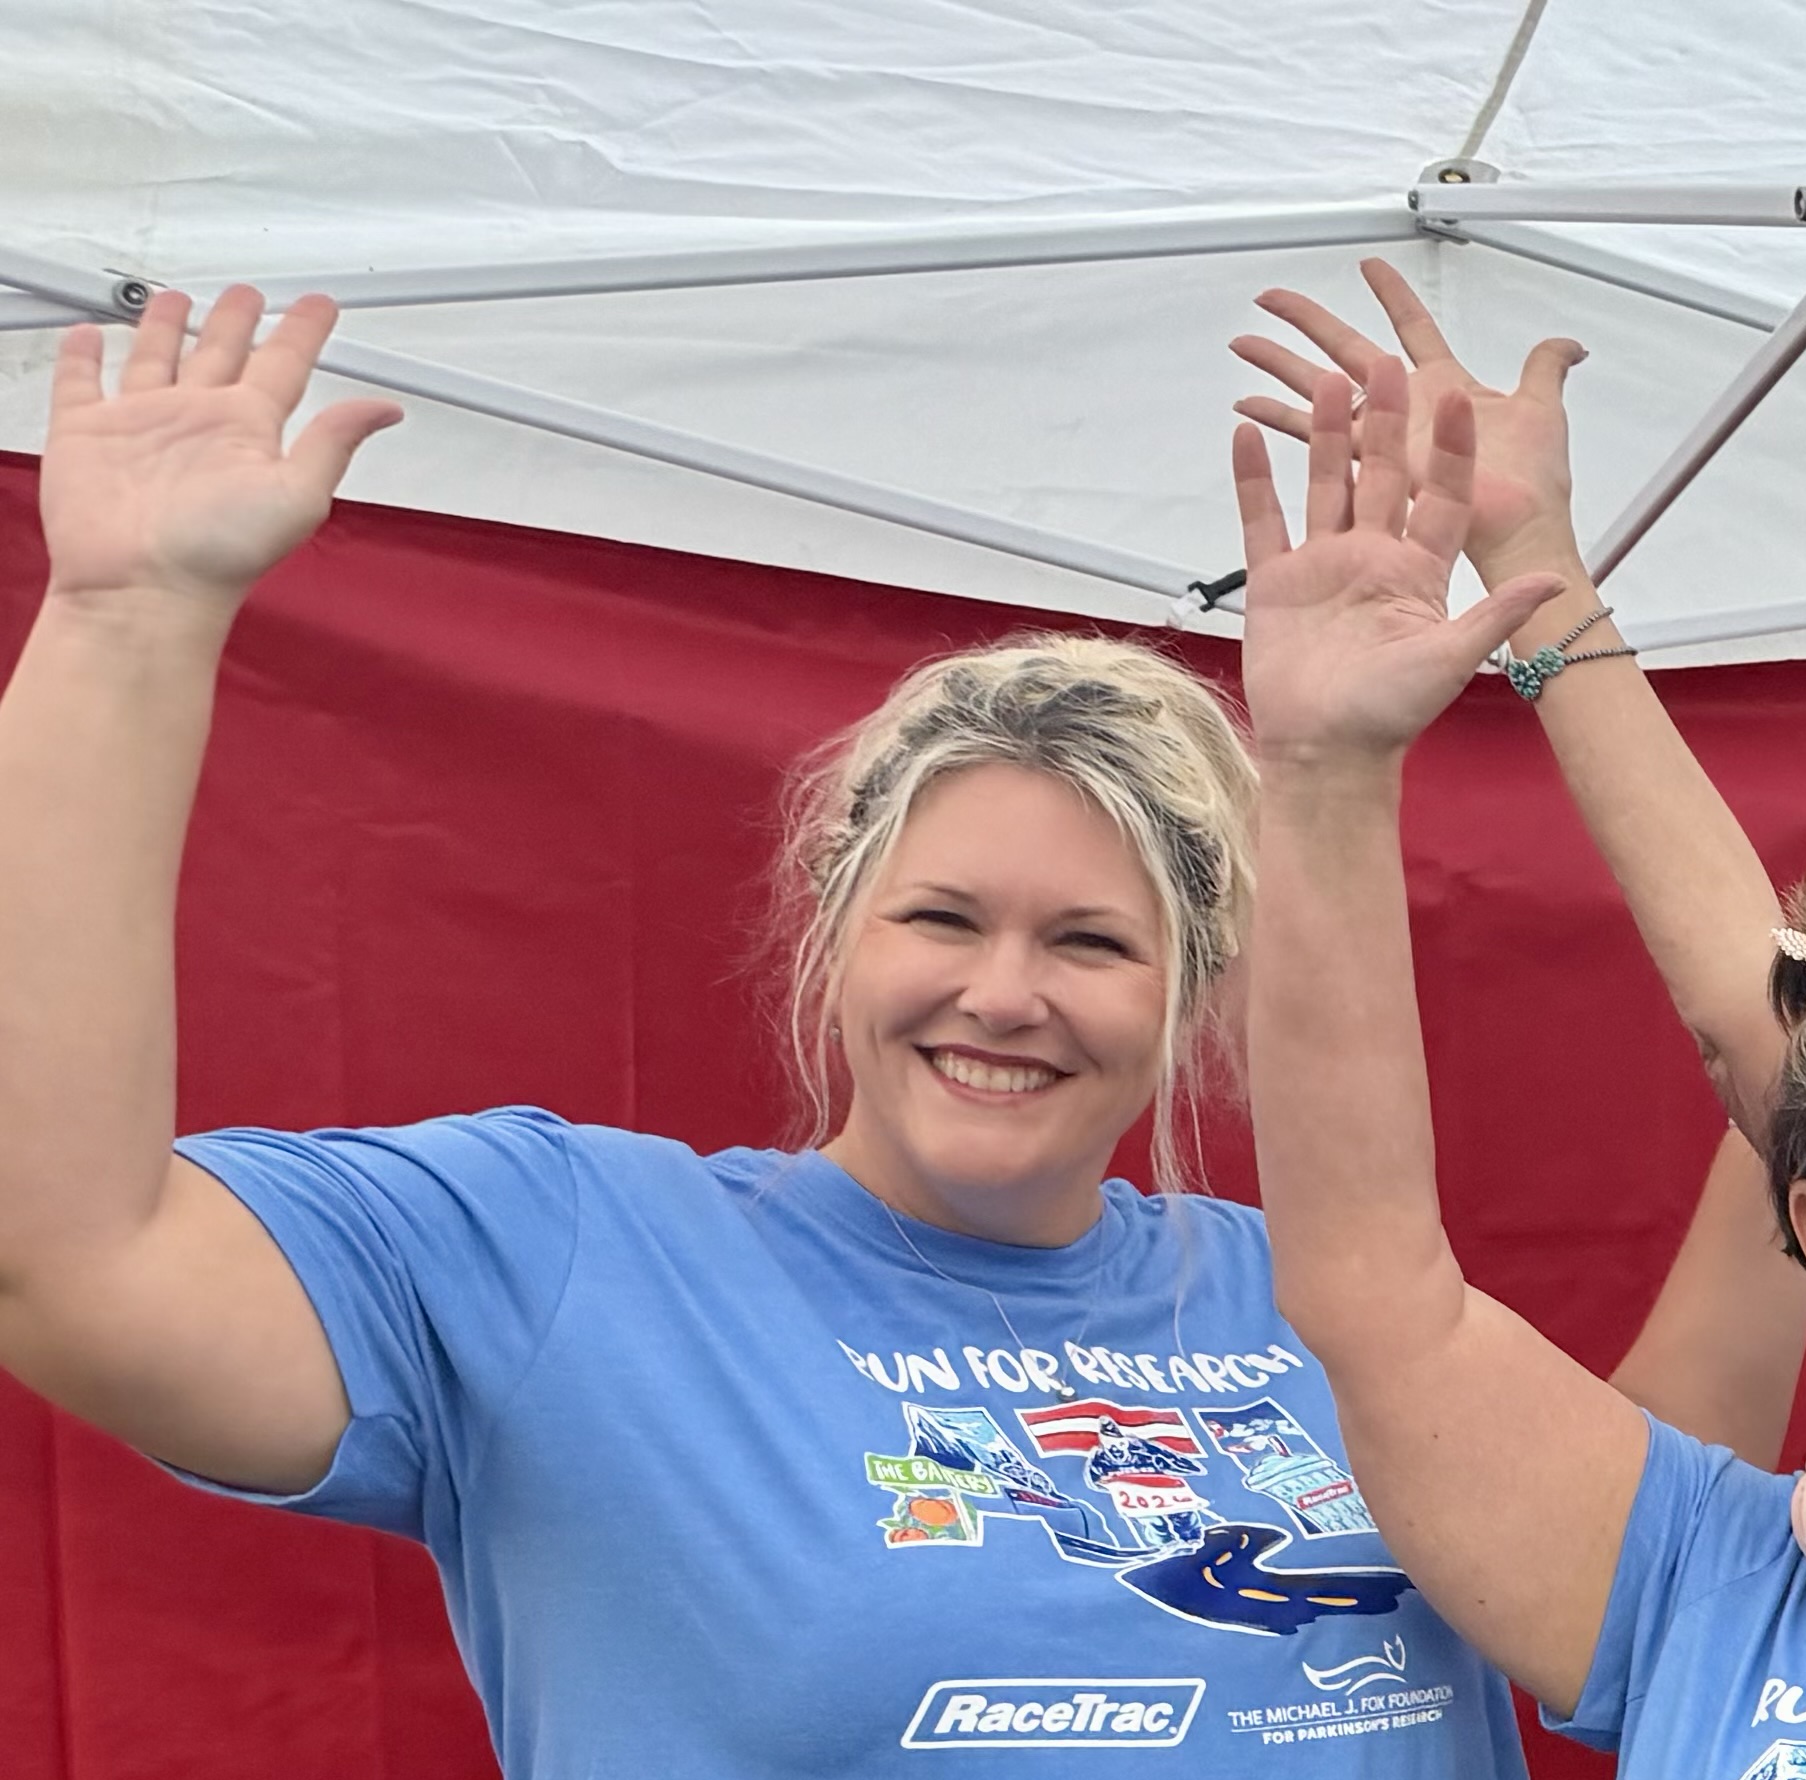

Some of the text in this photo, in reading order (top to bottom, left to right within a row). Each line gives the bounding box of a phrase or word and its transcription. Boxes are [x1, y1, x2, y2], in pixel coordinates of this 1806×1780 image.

[836, 1339, 1304, 1394] RUN FOR RESEARCH
[873, 1458, 991, 1494] THE BATTERY
[1227, 1685, 1454, 1727] THE MICHAEL J. FOX FOUNDATION
[1262, 1730, 1294, 1745] FOR
[1298, 1717, 1390, 1741] PARKINSON'S
